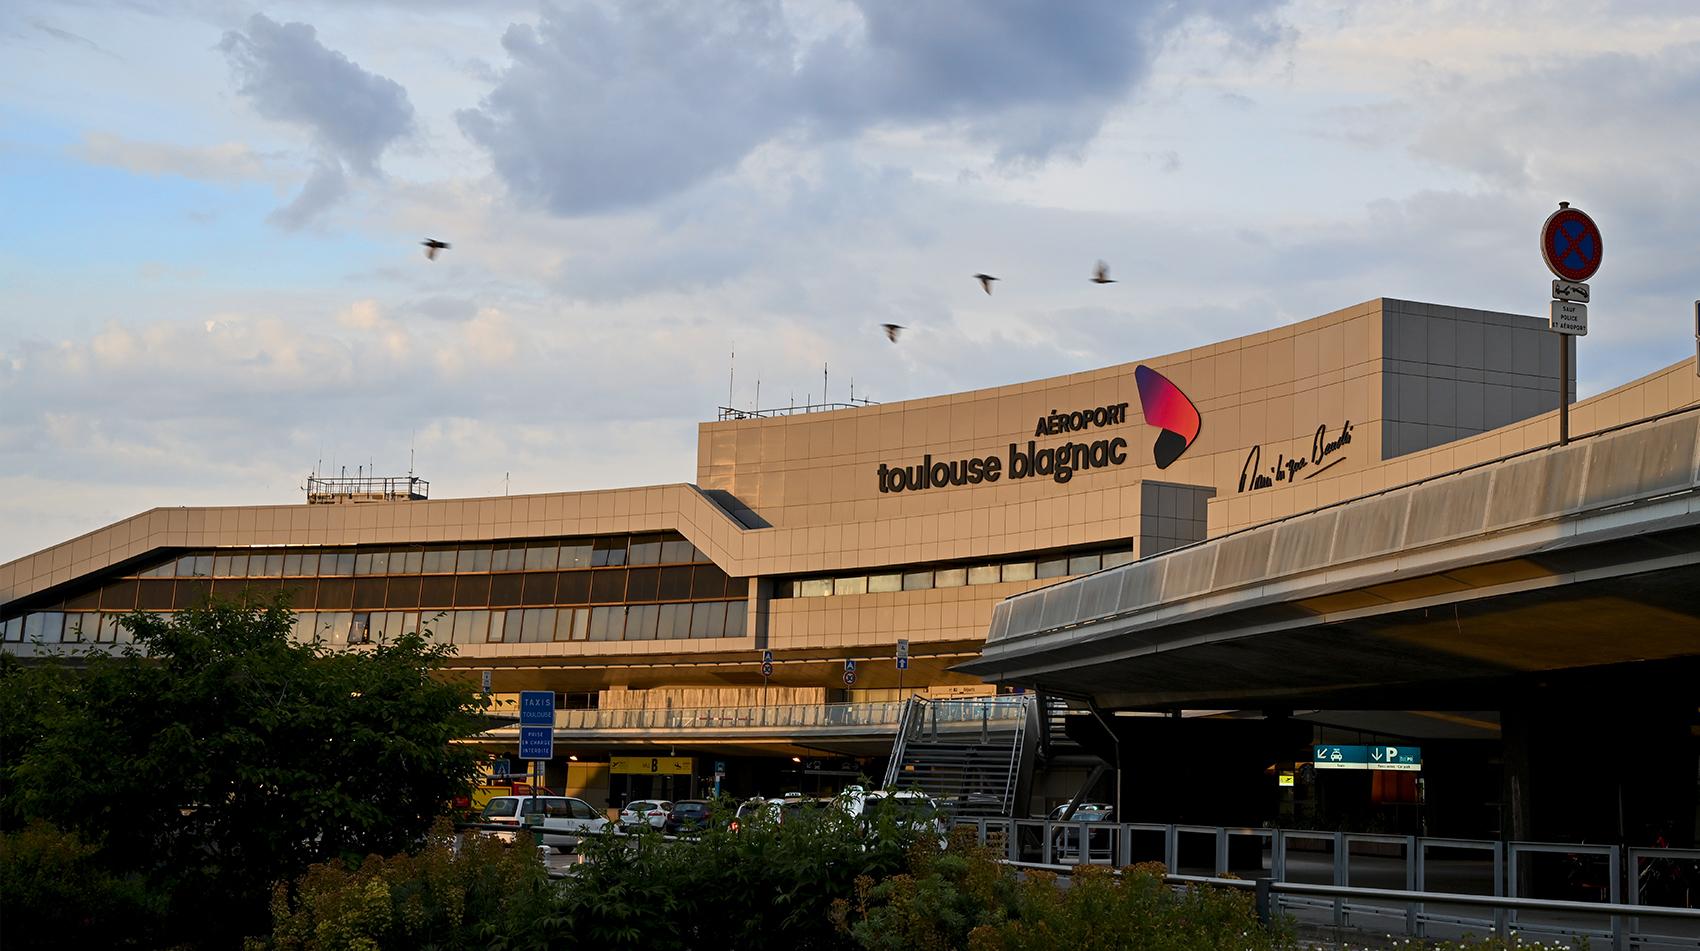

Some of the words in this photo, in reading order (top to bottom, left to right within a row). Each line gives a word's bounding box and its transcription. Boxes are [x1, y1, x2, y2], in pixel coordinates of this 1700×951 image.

[1560, 314, 1578, 322] POLICE
[1560, 322, 1586, 331] AÉROPORT
[1035, 403, 1129, 437] AÉROPORT
[878, 454, 1002, 493] toulouse
[1008, 437, 1128, 483] blagnac
[525, 698, 551, 706] TAXIS
[1386, 747, 1399, 762] P
[652, 759, 658, 772] B
